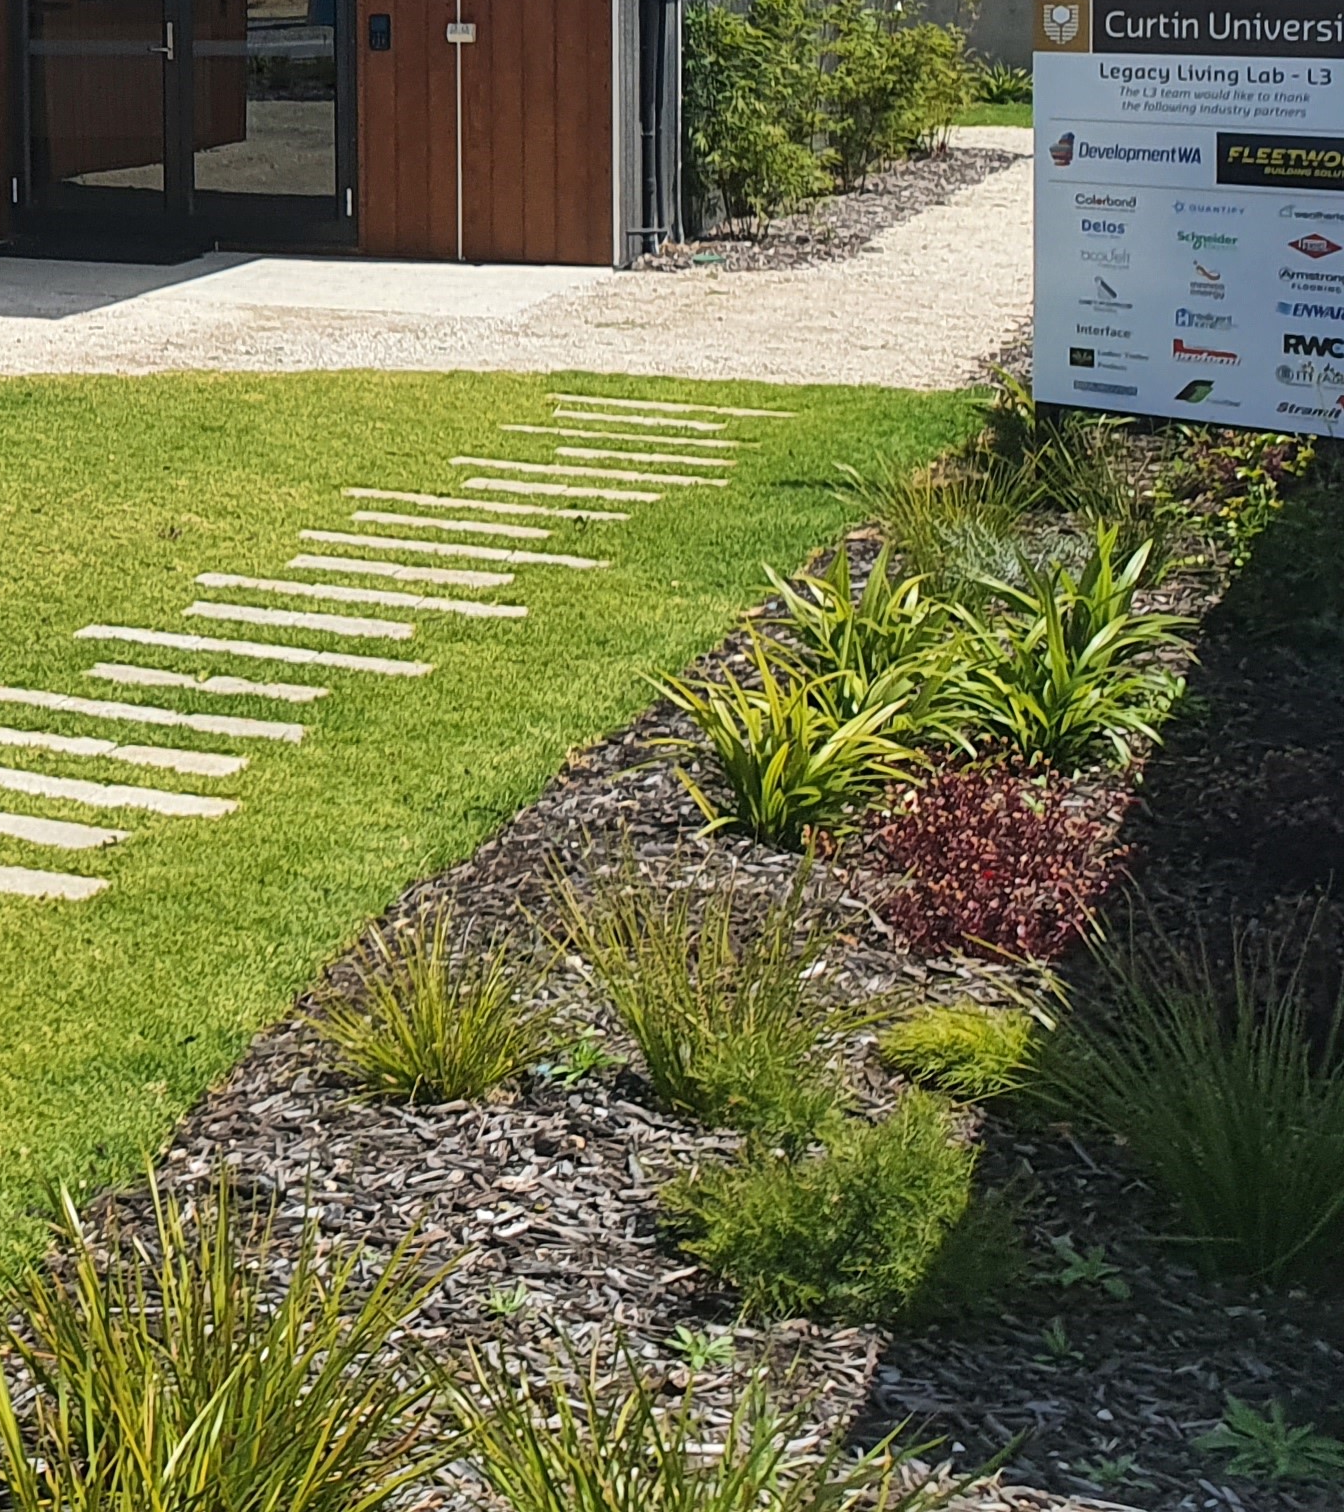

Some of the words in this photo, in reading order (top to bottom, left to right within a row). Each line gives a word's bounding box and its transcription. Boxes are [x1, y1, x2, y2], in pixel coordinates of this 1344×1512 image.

[1104, 10, 1200, 40] Curtin
[1099, 62, 1170, 84] Legacy
[1177, 64, 1240, 86] Living
[1247, 66, 1285, 85] Lab
[1307, 68, 1333, 86] L3
[1119, 86, 1140, 98] The
[1160, 87, 1191, 99] team
[1194, 89, 1231, 101] would
[1233, 90, 1255, 101] like
[1257, 90, 1271, 102] to
[1274, 91, 1311, 103] thank
[1122, 100, 1141, 111] the
[1143, 100, 1197, 116] following
[1254, 106, 1307, 119] partners
[1078, 141, 1202, 165] DevelopmentWA
[1227, 145, 1344, 168] FLEETWO
[1081, 218, 1126, 235] Delos
[1177, 229, 1239, 251] Schneider
[1076, 323, 1132, 339] Interface
